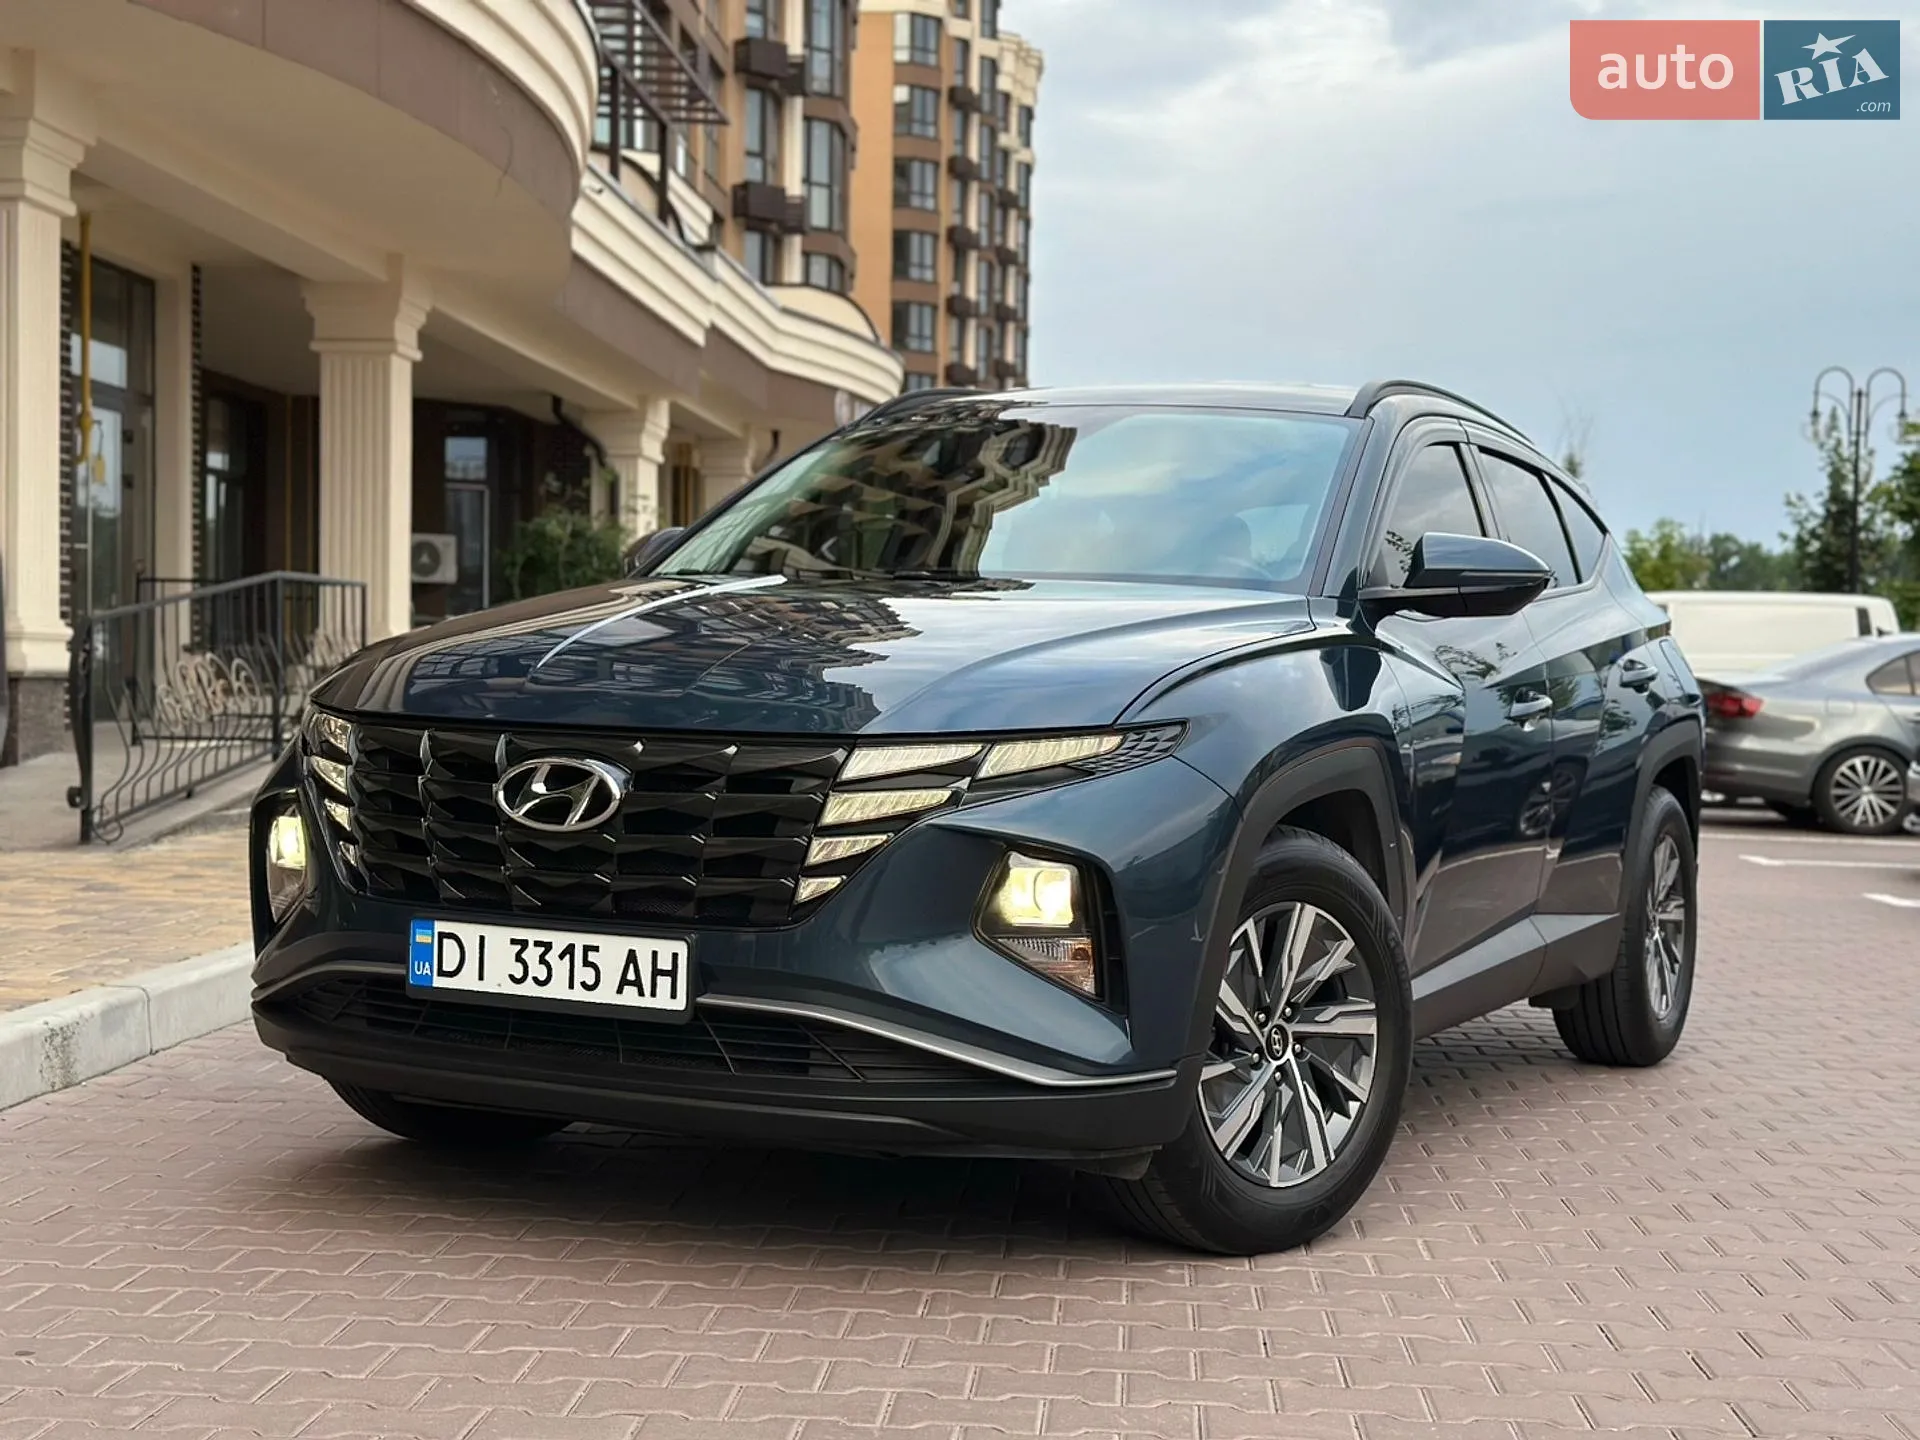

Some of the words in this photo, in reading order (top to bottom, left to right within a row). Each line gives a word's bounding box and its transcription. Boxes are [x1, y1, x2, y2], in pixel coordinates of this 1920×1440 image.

[414, 960, 431, 976] UA
[436, 931, 486, 982] DI
[508, 937, 601, 992] 3315
[615, 948, 679, 1000] AH
